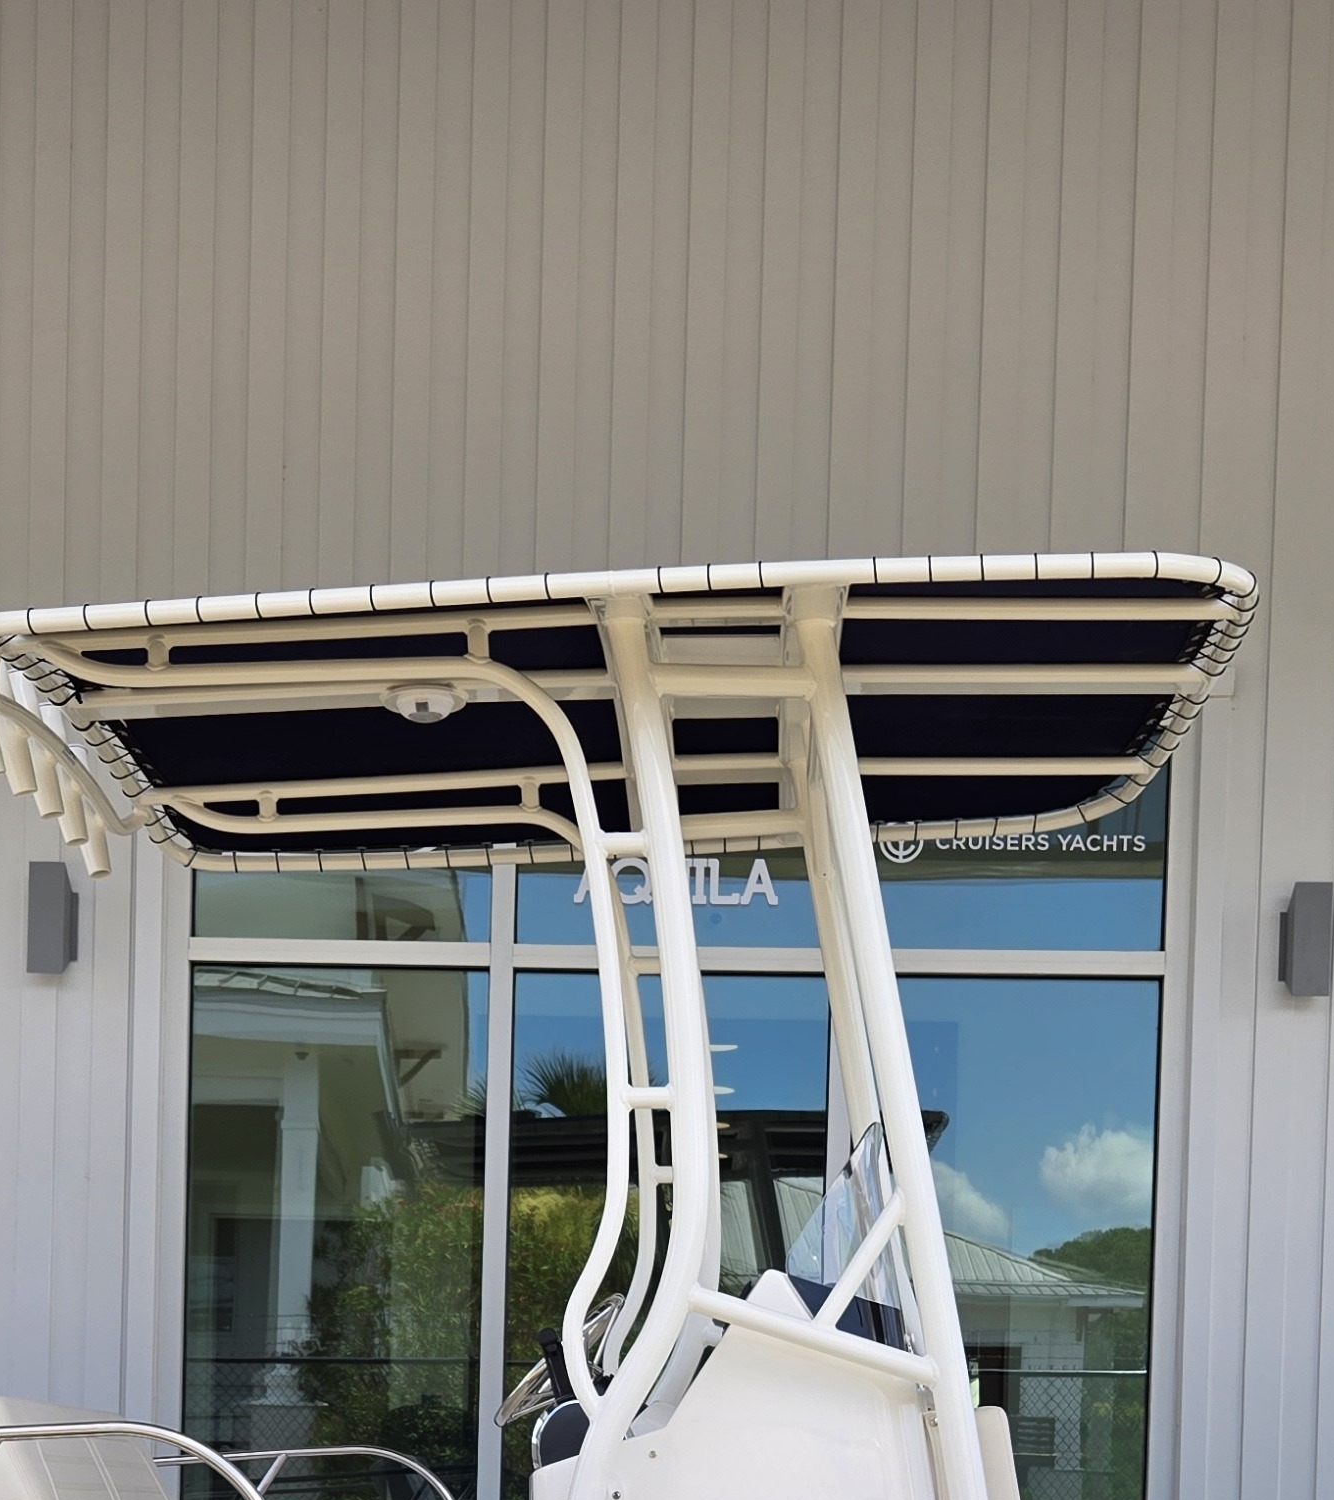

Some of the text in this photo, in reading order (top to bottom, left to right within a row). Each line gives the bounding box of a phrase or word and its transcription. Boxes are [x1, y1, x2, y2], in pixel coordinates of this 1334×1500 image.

[935, 833, 1147, 853] CRUISERS YACHTS
[573, 857, 779, 906] QILA
